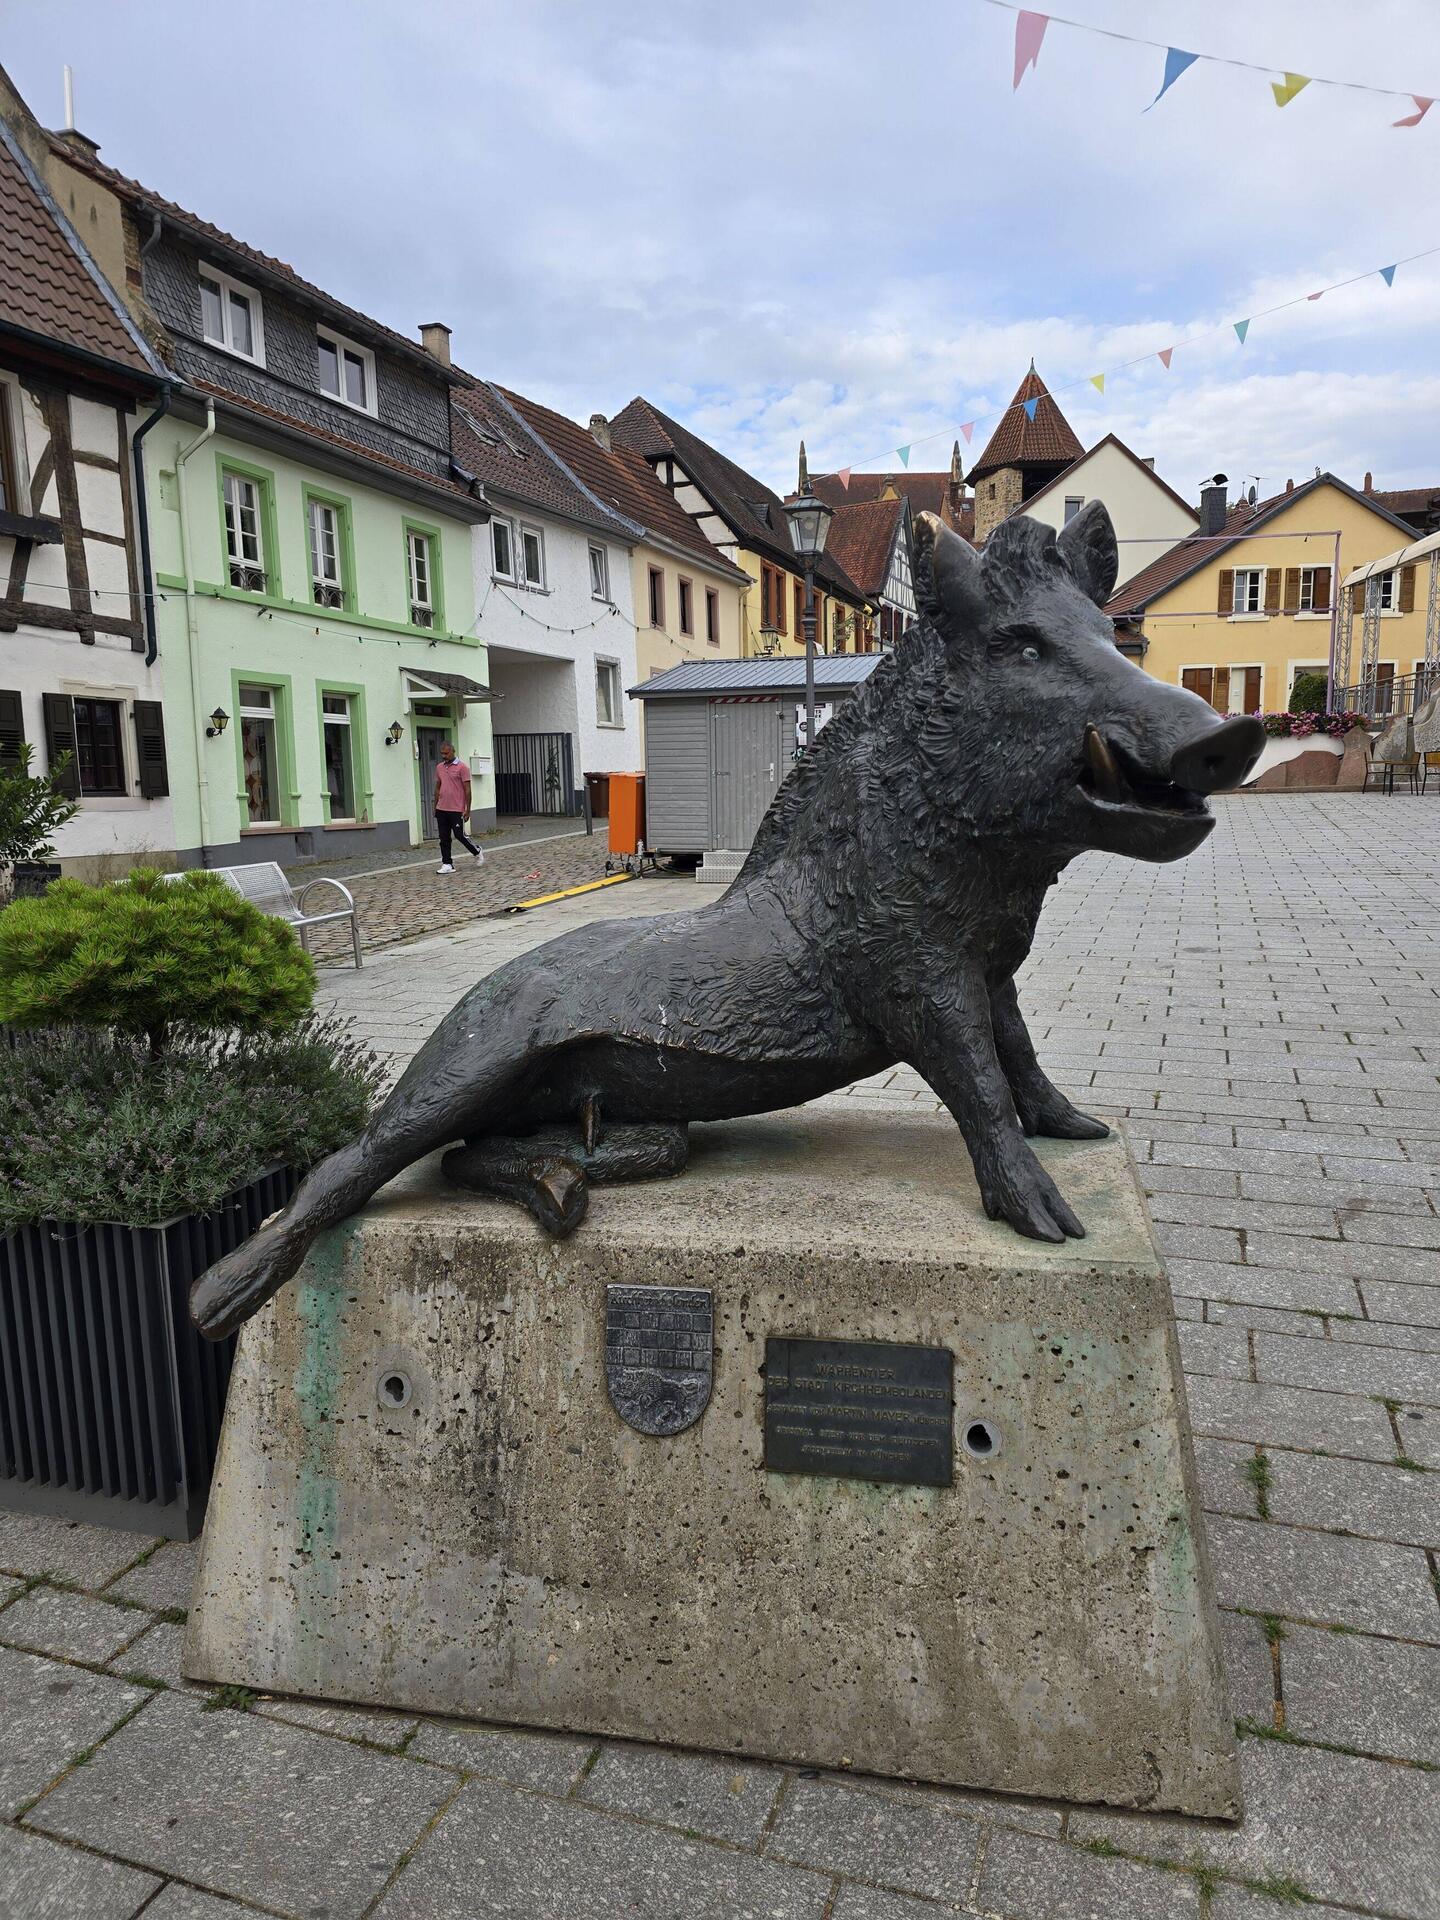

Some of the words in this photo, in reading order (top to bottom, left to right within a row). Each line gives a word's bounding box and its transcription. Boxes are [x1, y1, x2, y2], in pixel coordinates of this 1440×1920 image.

[815, 1363, 896, 1380] WAPPENTIER
[767, 1375, 790, 1389] DER
[795, 1377, 828, 1391] STADT
[833, 1380, 951, 1401] KIRCHHEIMBOLANDEN
[827, 1405, 868, 1420] MARTIN
